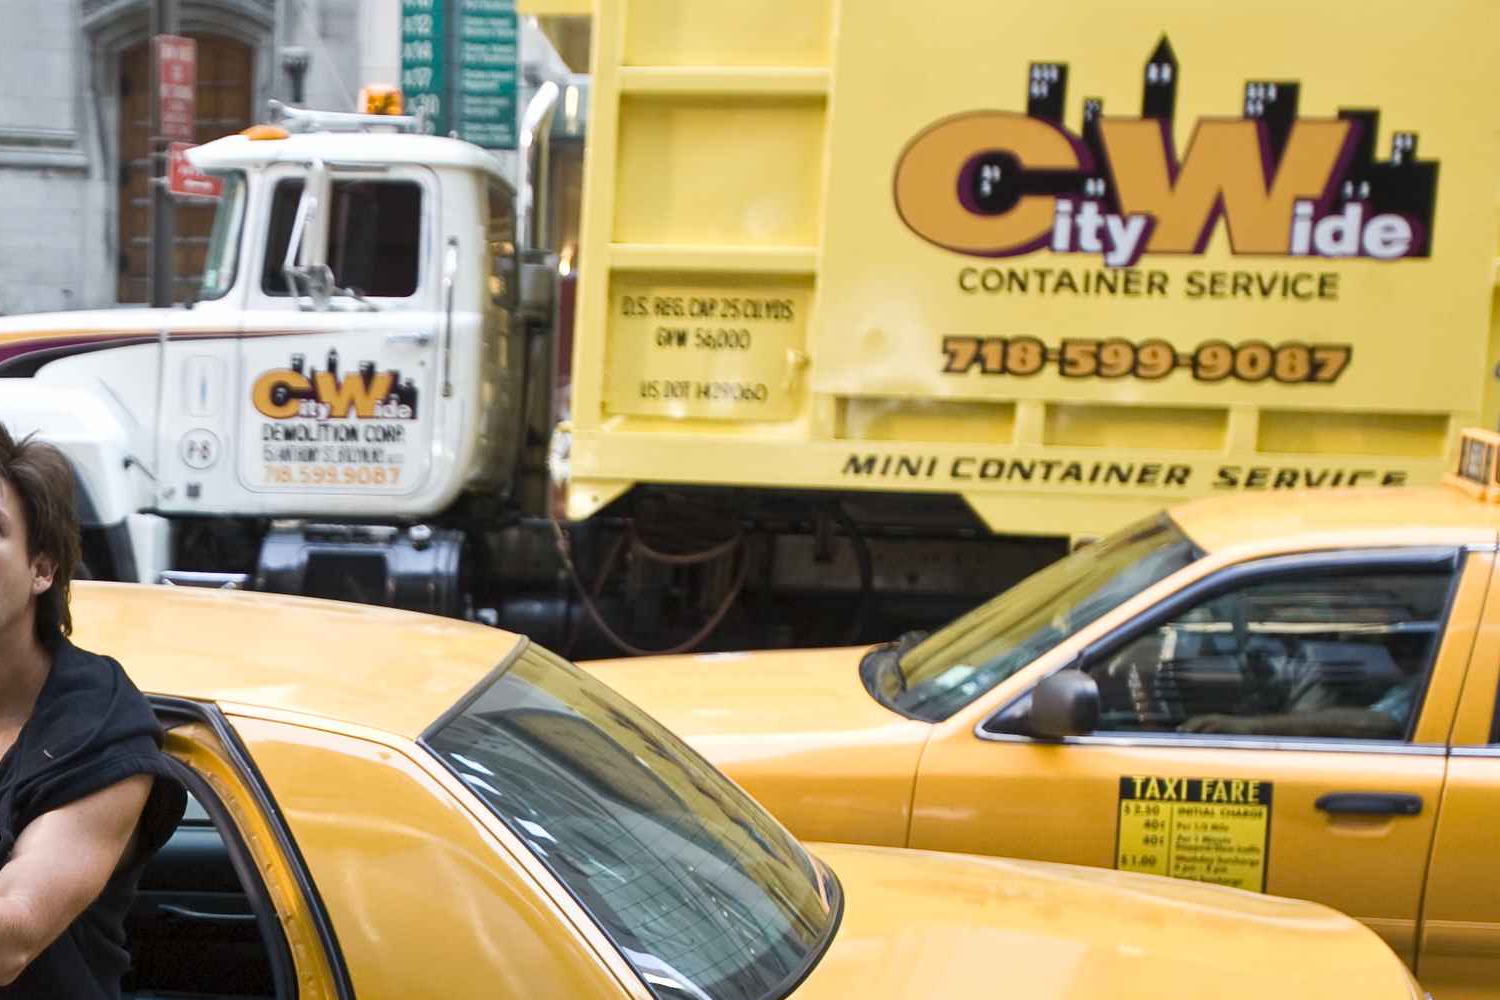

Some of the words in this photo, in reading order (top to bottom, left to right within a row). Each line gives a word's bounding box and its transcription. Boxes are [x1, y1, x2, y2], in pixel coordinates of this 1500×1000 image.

[958, 267, 1169, 297] CONTAINER
[1185, 272, 1340, 300] SERVICE
[695, 328, 751, 349] 56,000
[942, 335, 1353, 384] 718-599-9087
[262, 423, 358, 442] DEMOLITION
[842, 453, 940, 479] MINI
[950, 457, 1193, 489] CONTAINER
[1131, 776, 1188, 800] TAXI
[1200, 779, 1260, 802] FARE
